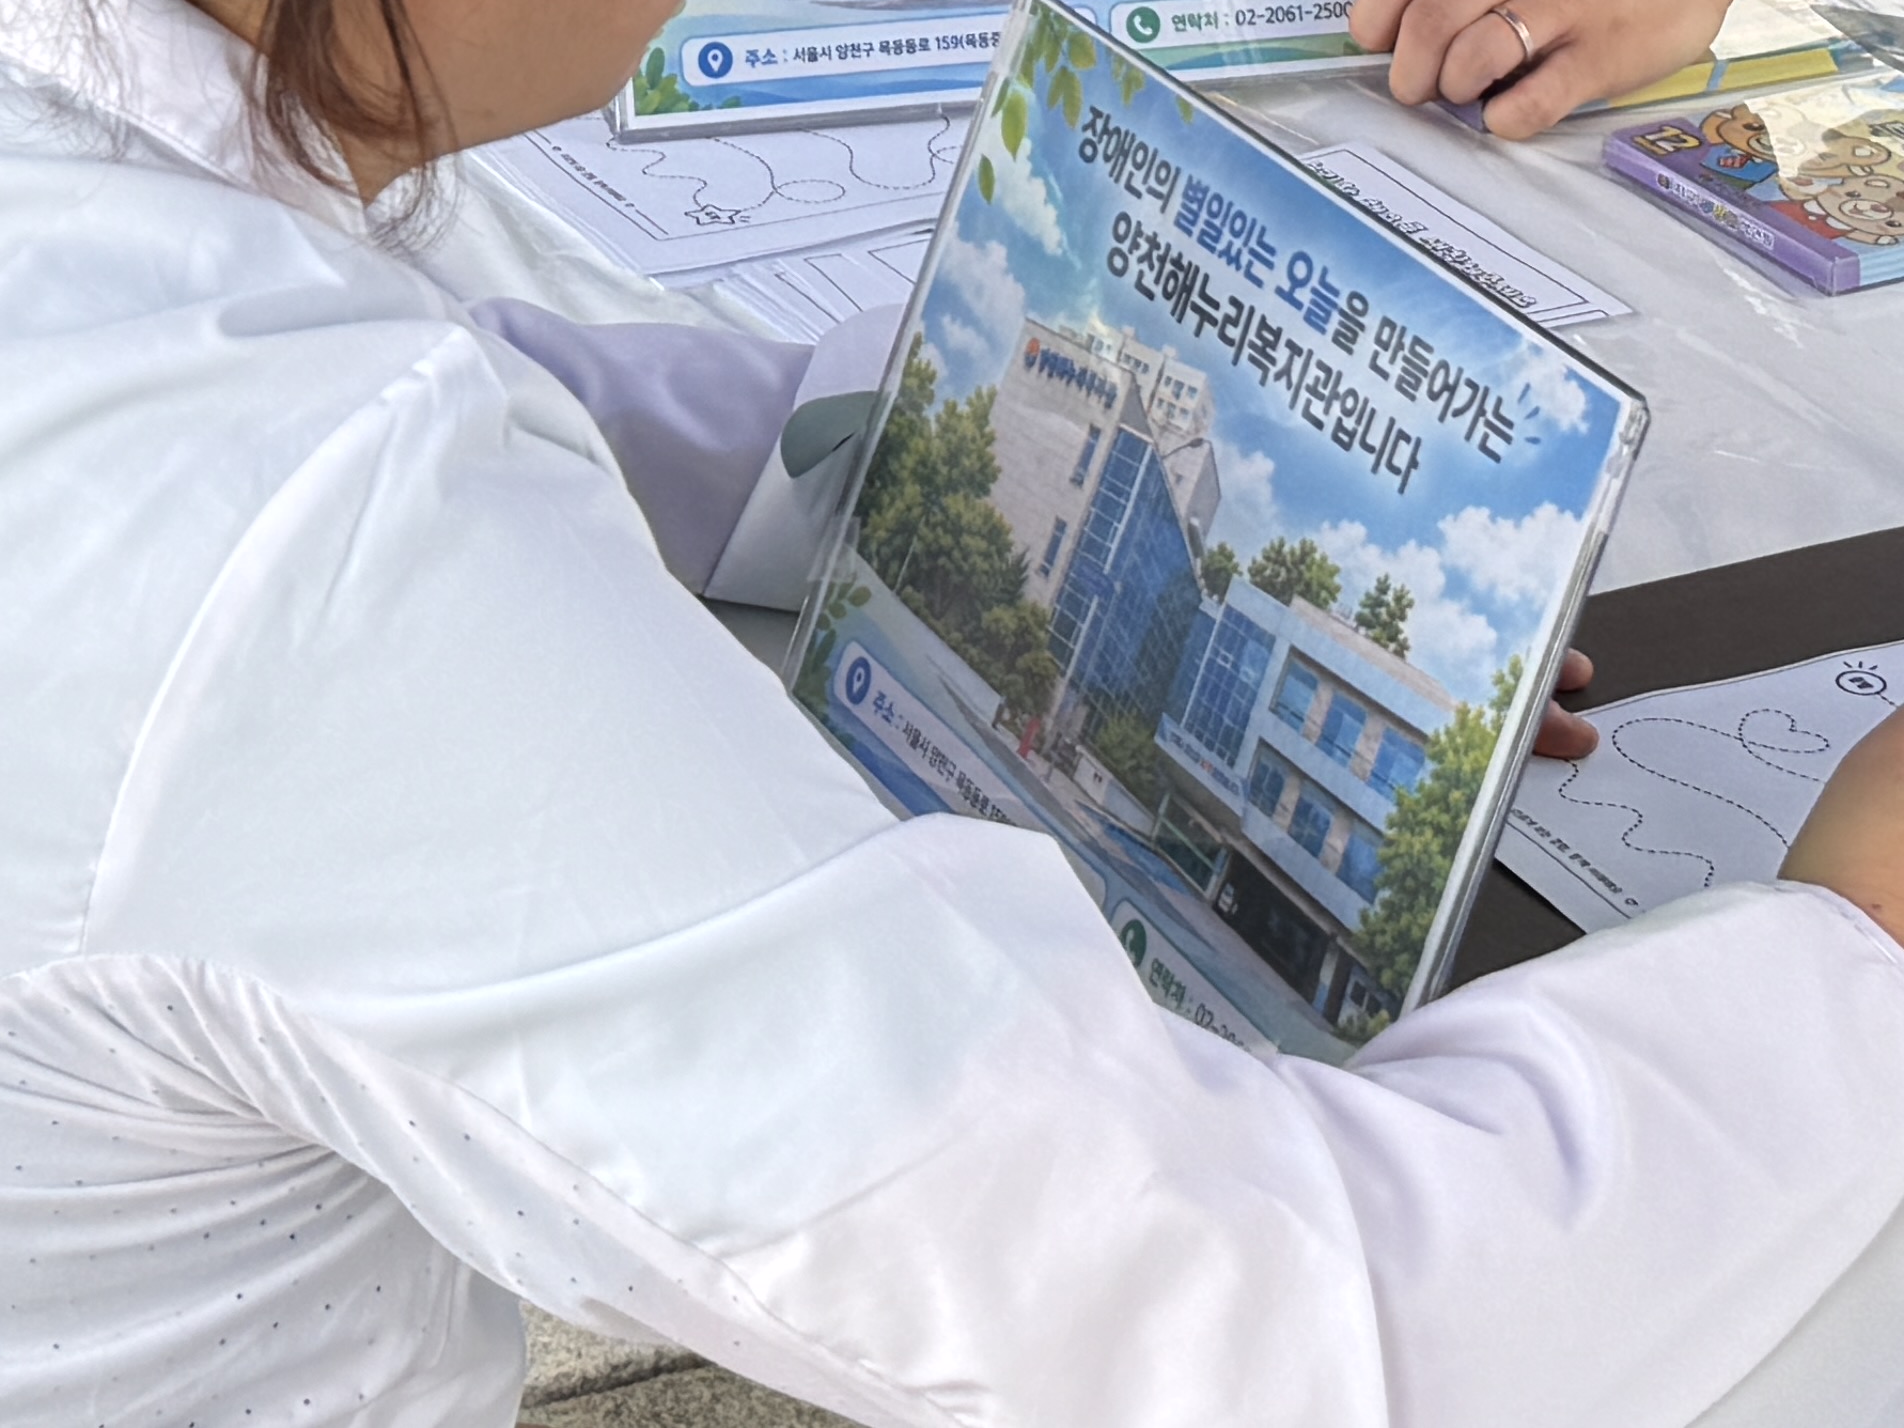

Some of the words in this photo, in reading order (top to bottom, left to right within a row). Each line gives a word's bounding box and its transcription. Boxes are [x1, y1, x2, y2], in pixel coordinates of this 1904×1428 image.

[745, 48, 778, 68] 주소
[793, 46, 832, 63] 서울시
[836, 42, 875, 60] 양천구
[1077, 106, 1182, 214] 장애인의
[1172, 174, 1275, 290] 별일있는
[1274, 250, 1371, 356] 오늘을
[1367, 314, 1515, 464] 만들어가는
[1106, 209, 1424, 496] 양천해누리복지관입니다
[872, 689, 895, 725] 주소
